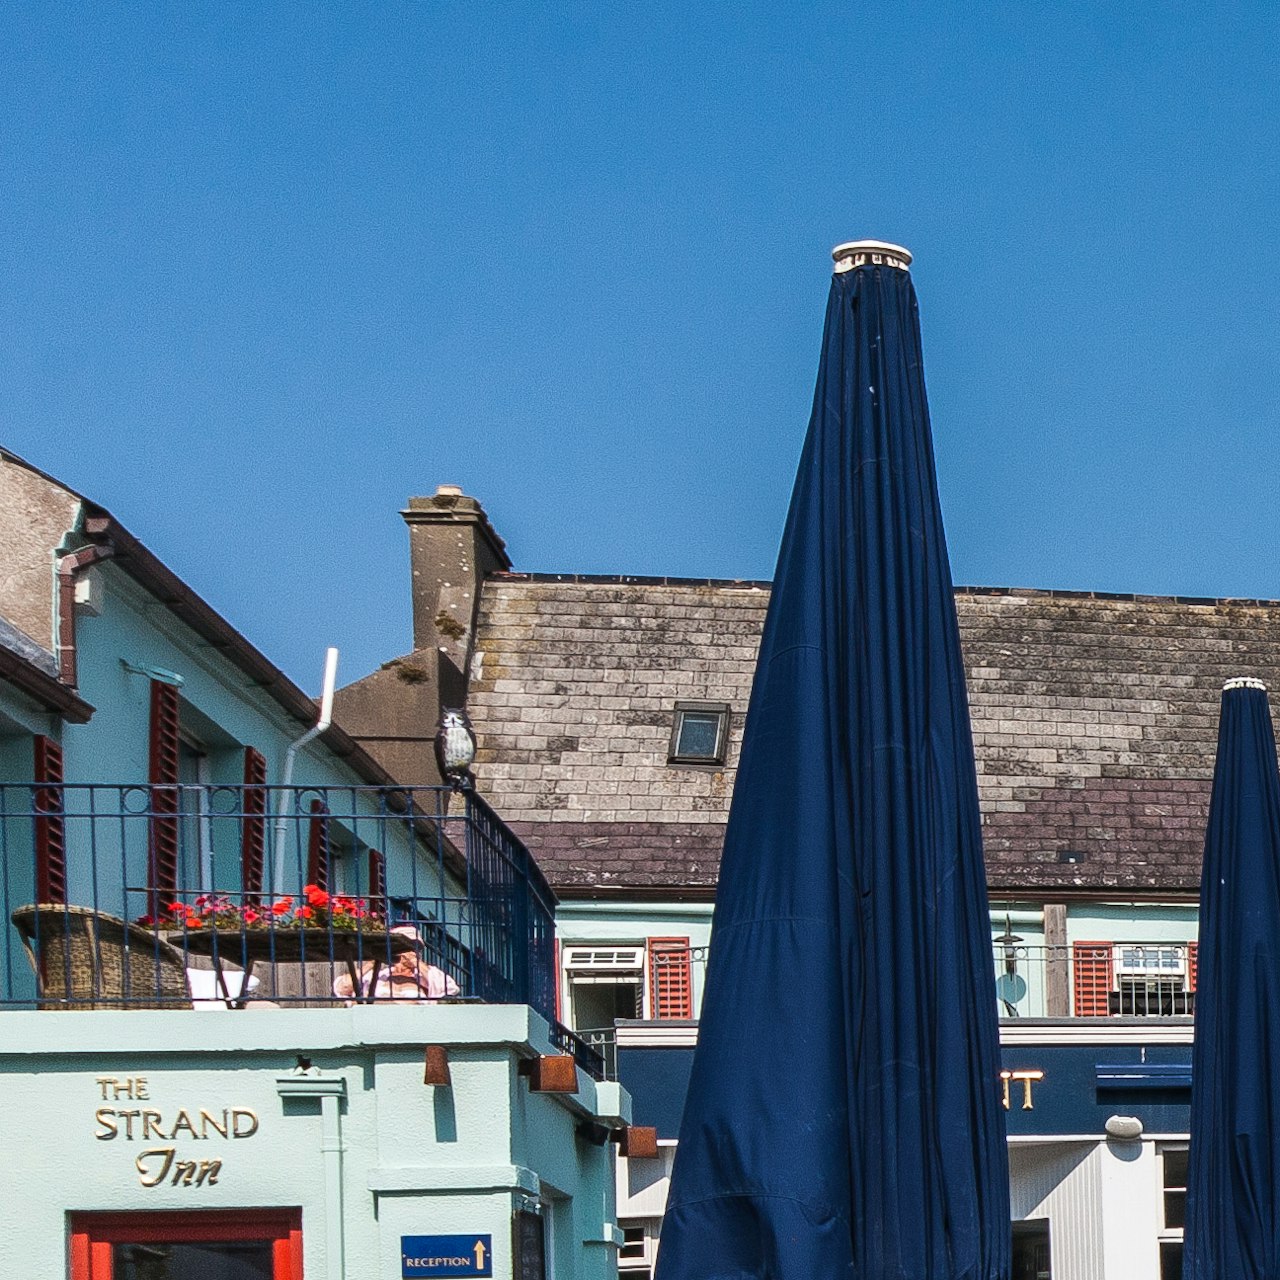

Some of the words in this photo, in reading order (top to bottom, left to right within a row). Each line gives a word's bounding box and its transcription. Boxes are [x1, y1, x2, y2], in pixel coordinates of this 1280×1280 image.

[96, 1076, 149, 1100] THE
[95, 1106, 259, 1140] STRAND
[136, 1146, 223, 1187] Inn
[406, 1257, 470, 1267] RECEPTION
